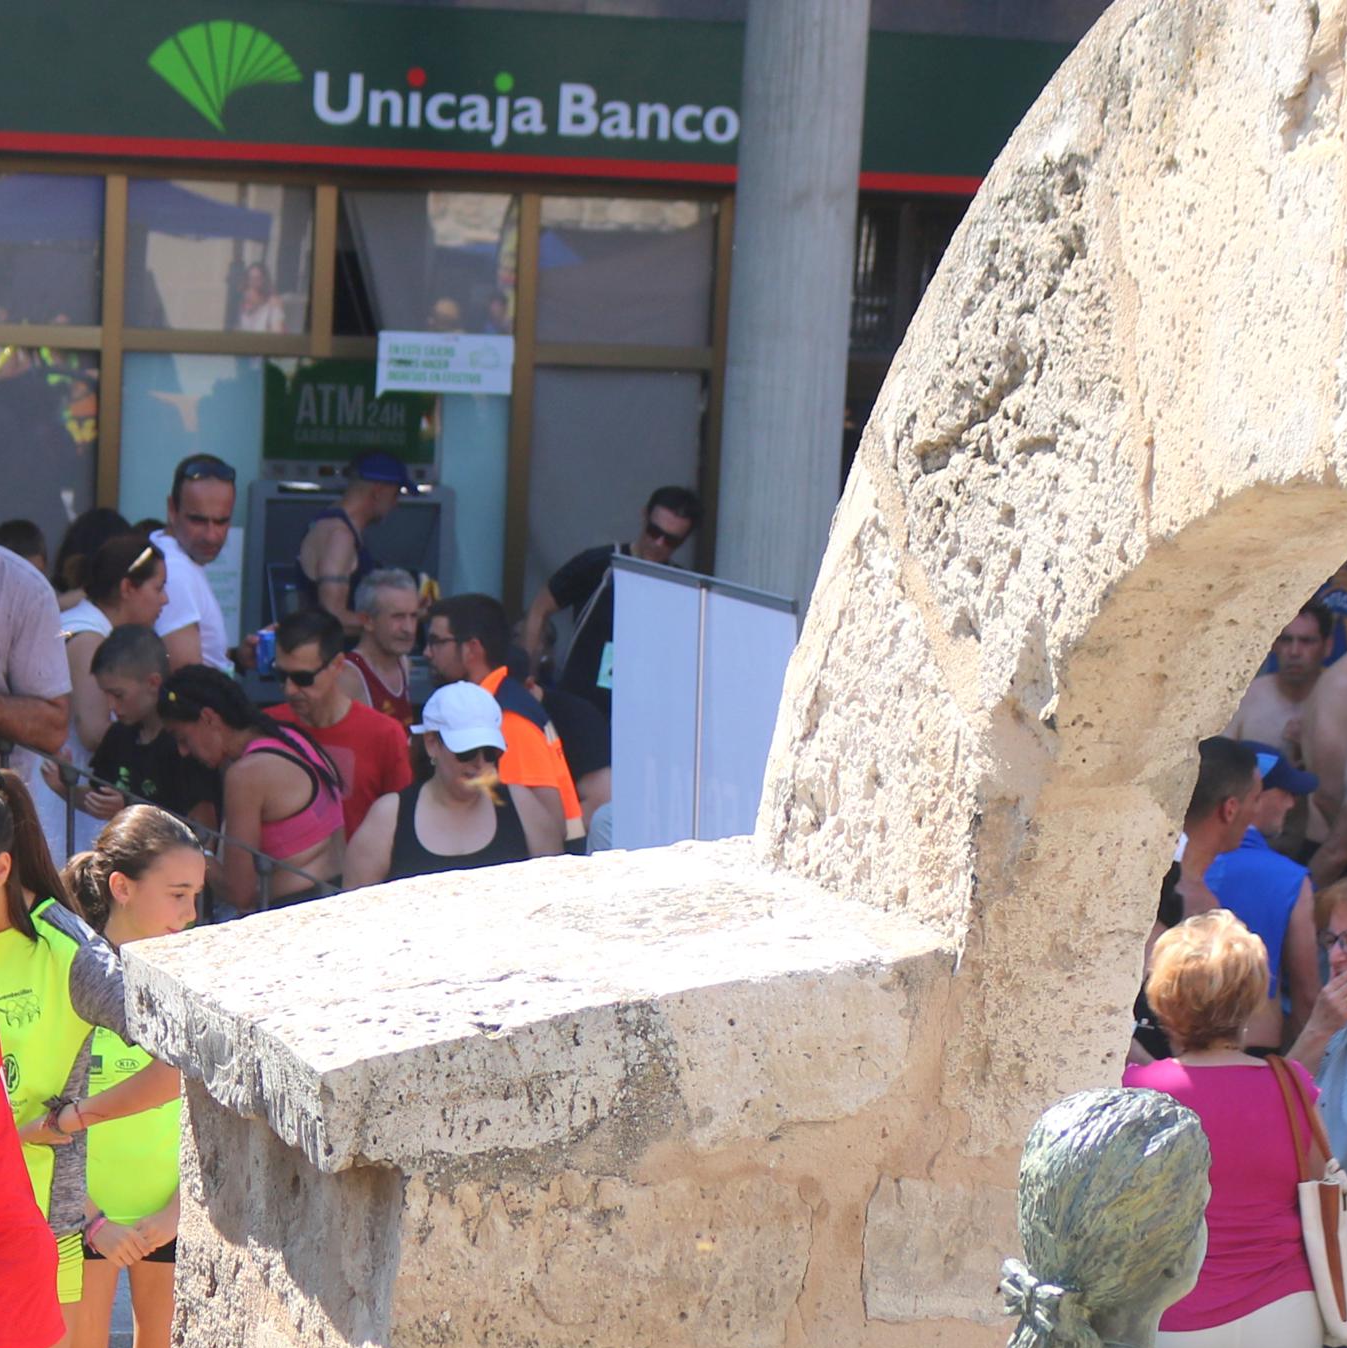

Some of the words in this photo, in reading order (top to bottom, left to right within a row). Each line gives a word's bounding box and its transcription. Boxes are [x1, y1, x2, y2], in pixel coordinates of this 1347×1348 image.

[314, 67, 546, 147] Unicaja
[558, 83, 740, 144] Banco
[296, 383, 365, 426] ATM
[366, 401, 407, 428] 24H
